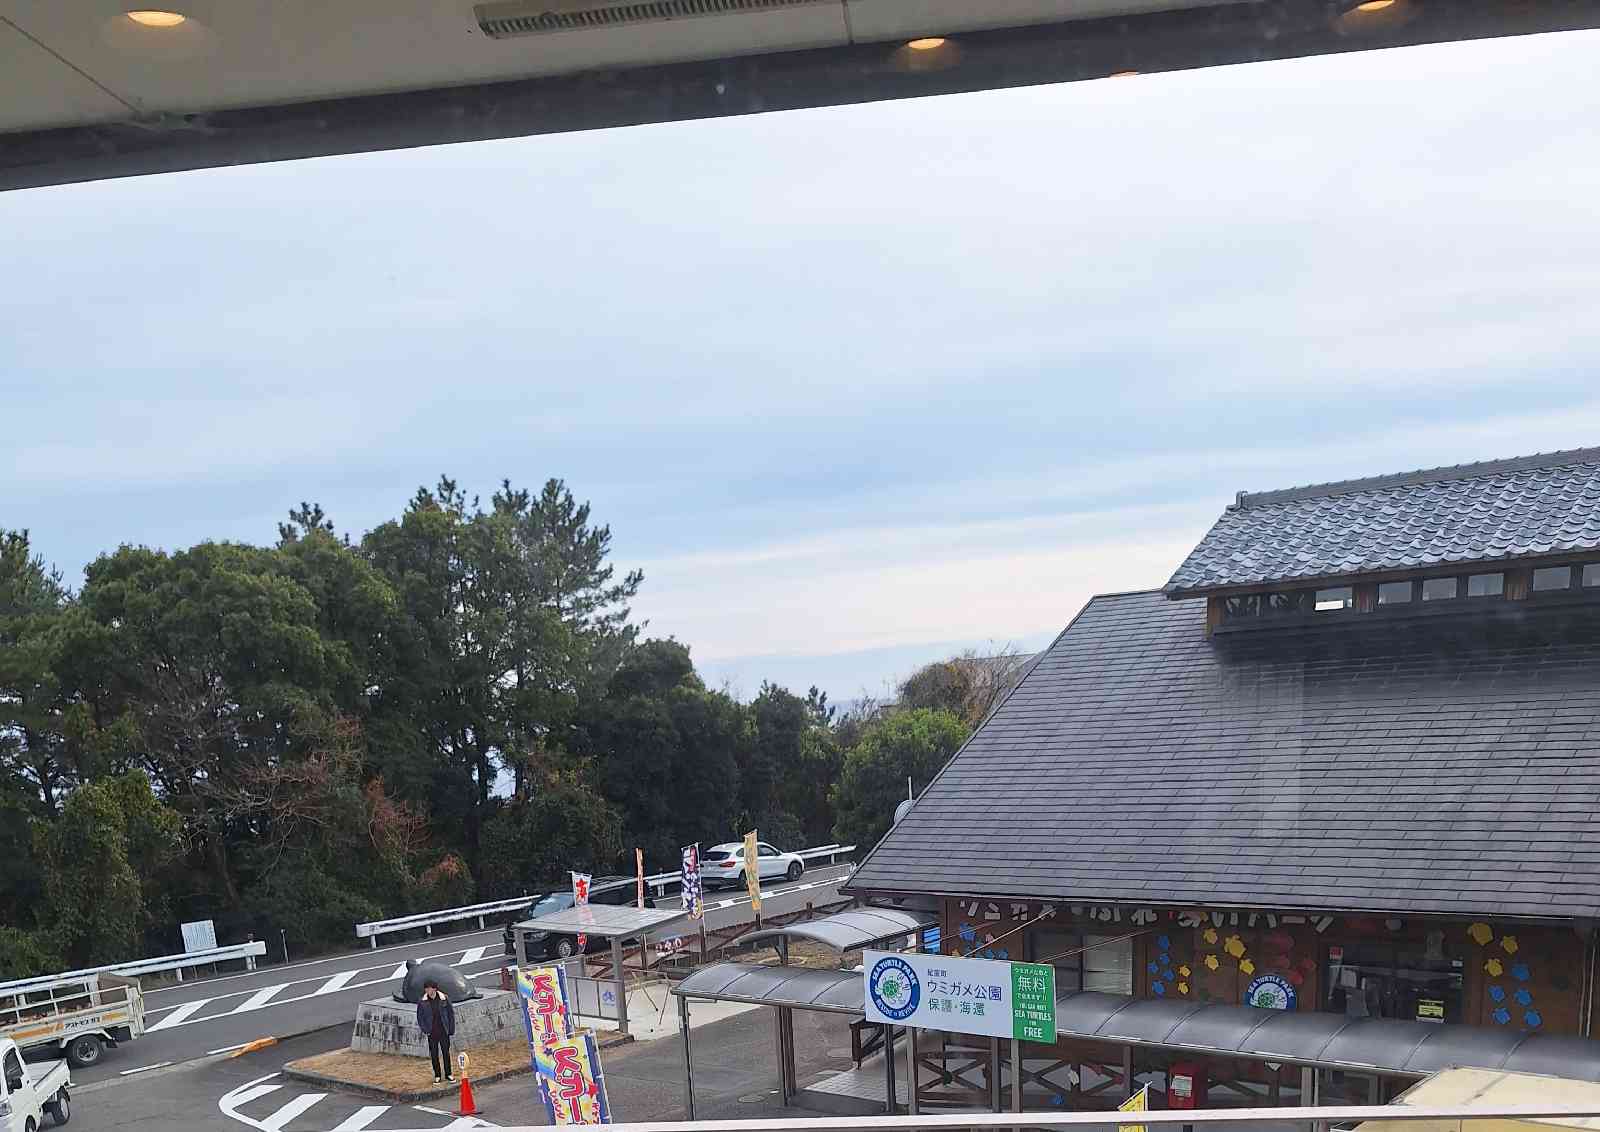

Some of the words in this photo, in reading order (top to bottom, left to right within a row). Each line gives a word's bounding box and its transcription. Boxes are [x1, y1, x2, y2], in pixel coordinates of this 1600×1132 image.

[927, 980, 1002, 1001] ウミガメ公園
[1018, 975, 1048, 993] 無料
[1014, 1009, 1026, 1018] SEA
[1027, 1011, 1052, 1021] TURTLES
[1024, 1027, 1043, 1039] FREE
